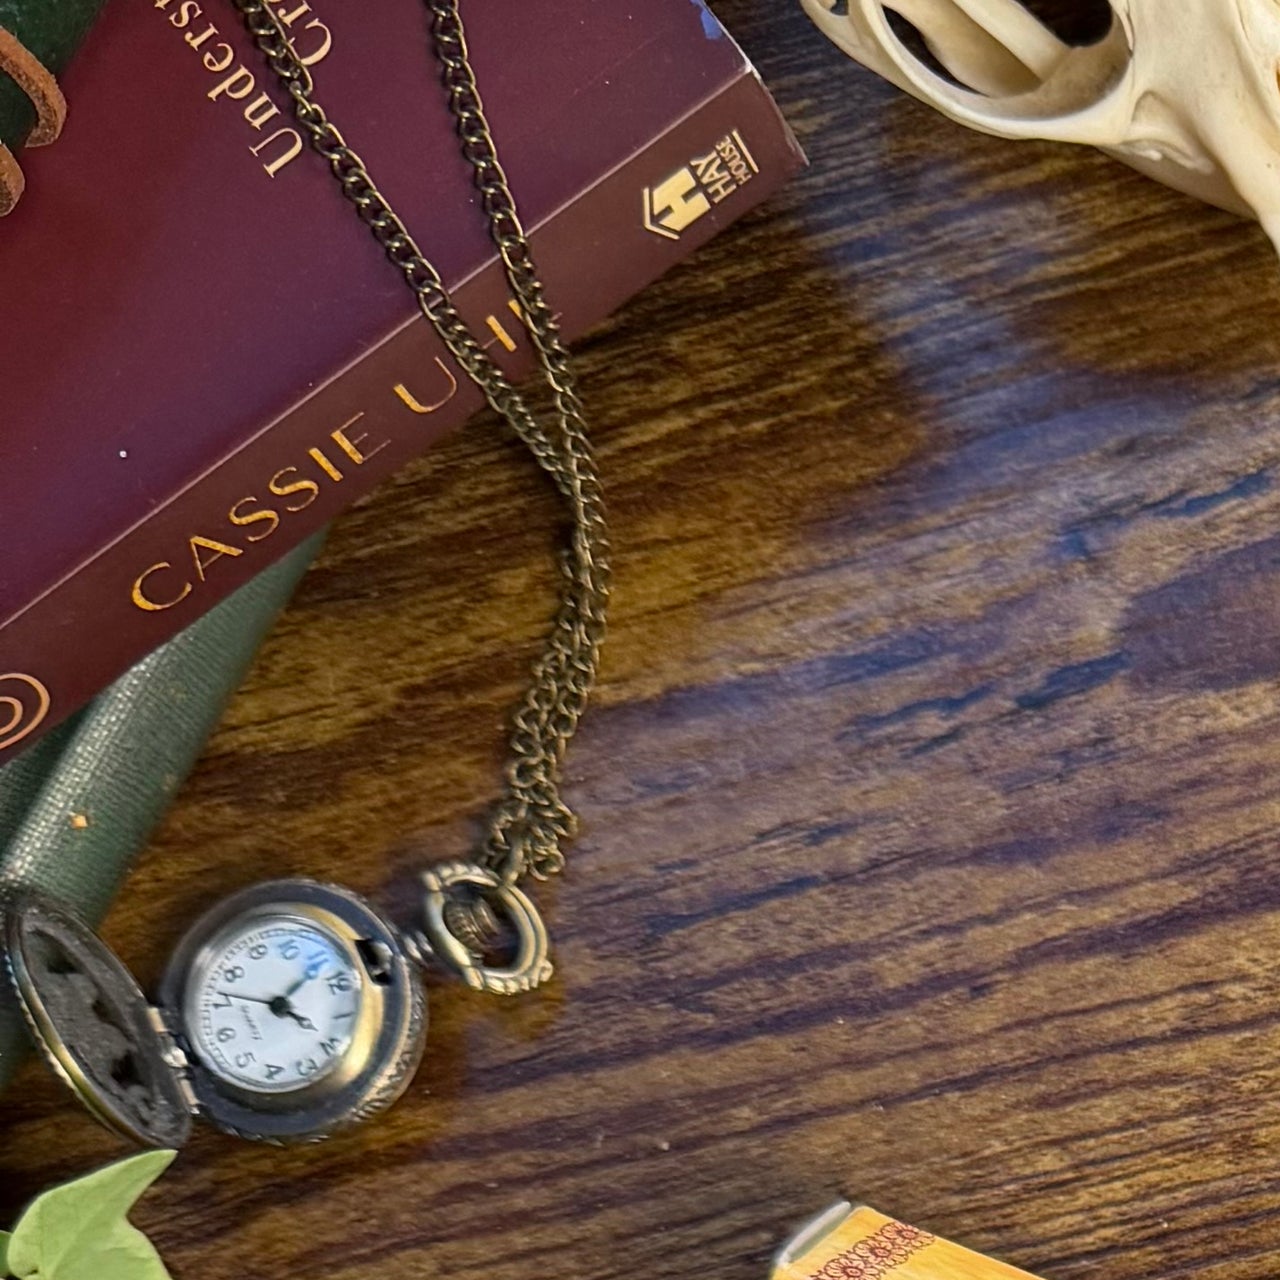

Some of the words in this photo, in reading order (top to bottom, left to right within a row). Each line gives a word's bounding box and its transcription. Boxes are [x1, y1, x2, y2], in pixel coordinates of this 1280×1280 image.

[264, 0, 332, 66] Cr
[155, 0, 303, 178] Unders
[690, 151, 737, 203] HAY
[715, 136, 752, 185] HOUSE
[133, 413, 390, 610] CASSIE
